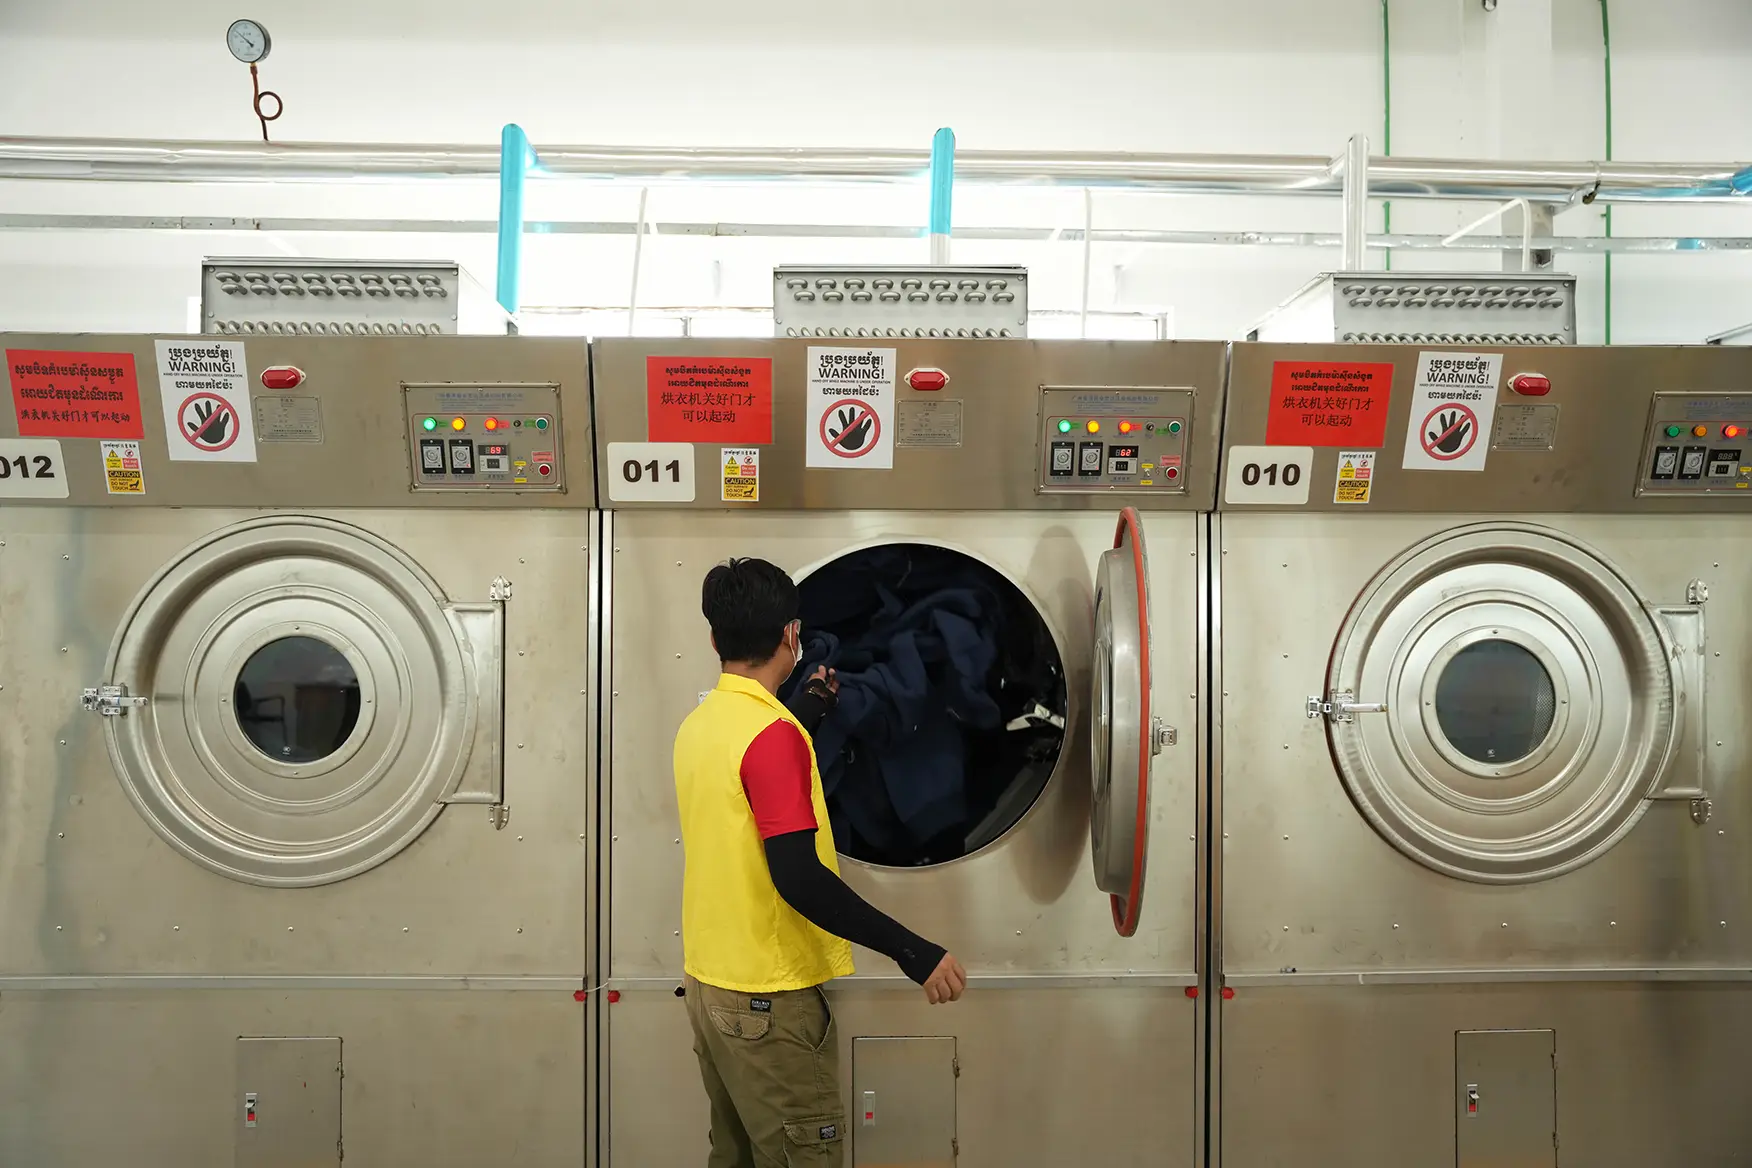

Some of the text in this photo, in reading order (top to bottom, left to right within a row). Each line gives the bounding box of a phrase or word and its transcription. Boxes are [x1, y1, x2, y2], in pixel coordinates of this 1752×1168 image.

[168, 361, 236, 373] WARNING!
[818, 368, 885, 379] WARNING!
[1426, 372, 1490, 384] WARNING!
[660, 391, 756, 406] 烘衣机关好门才
[1282, 396, 1375, 411] 烘衣机关好门才
[681, 409, 736, 423] 可以起动
[1301, 413, 1353, 427] 可以起动
[490, 446, 502, 455] 69
[0, 455, 55, 479] 012
[622, 459, 680, 483] 011
[1241, 463, 1301, 486] 010
